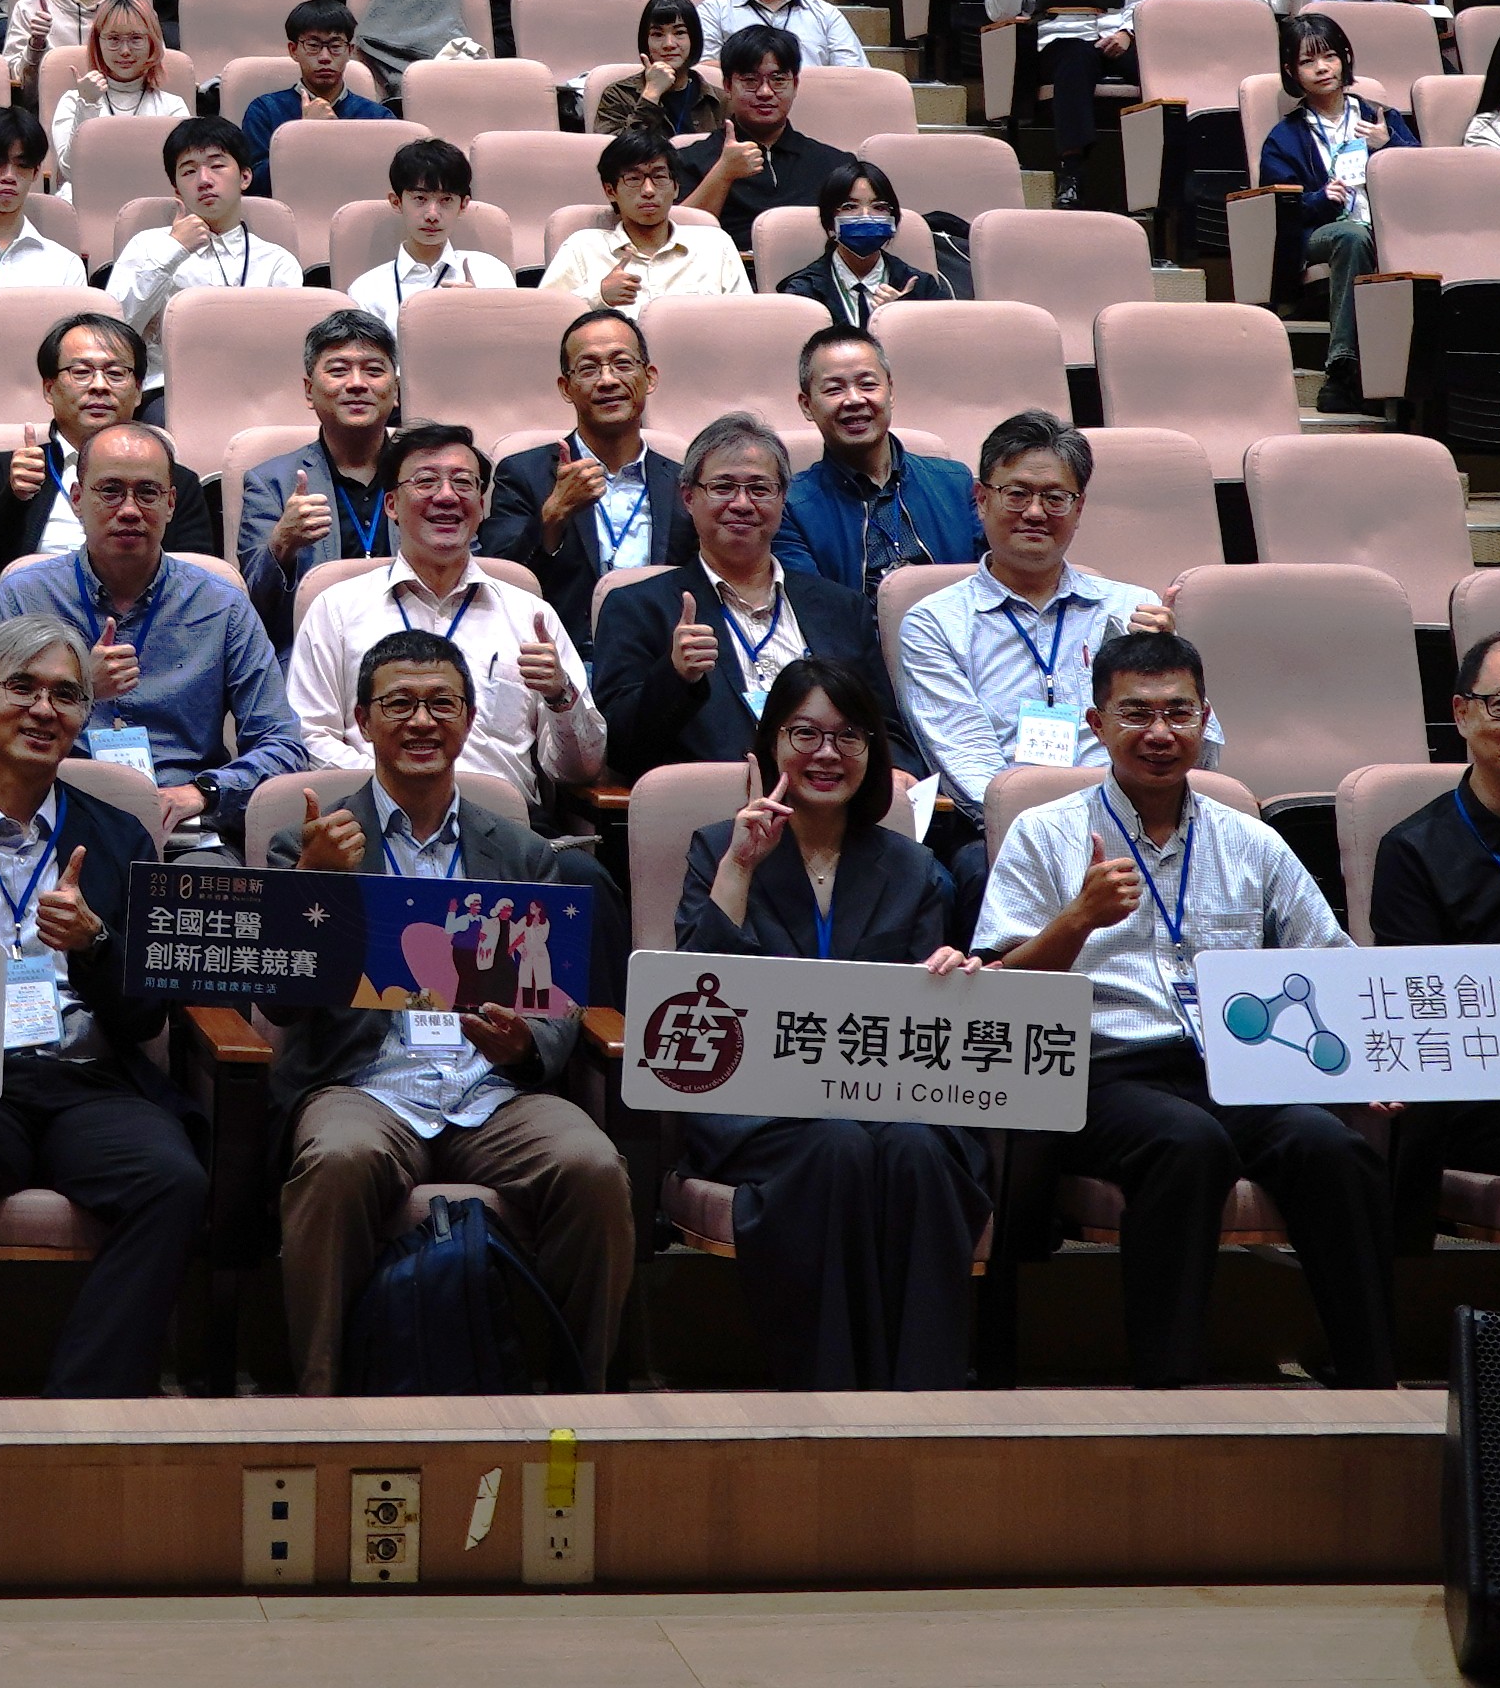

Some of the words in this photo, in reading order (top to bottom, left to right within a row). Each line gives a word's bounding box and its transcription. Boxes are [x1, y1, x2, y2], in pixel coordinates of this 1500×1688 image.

[150, 873, 168, 884] 20
[150, 886, 167, 897] 25
[147, 905, 262, 941] 全國生醫
[145, 941, 319, 979] 創新創業競賽
[773, 1010, 1077, 1077] 跨領域學院
[821, 1080, 882, 1101] TMU
[911, 1083, 1008, 1110] College
